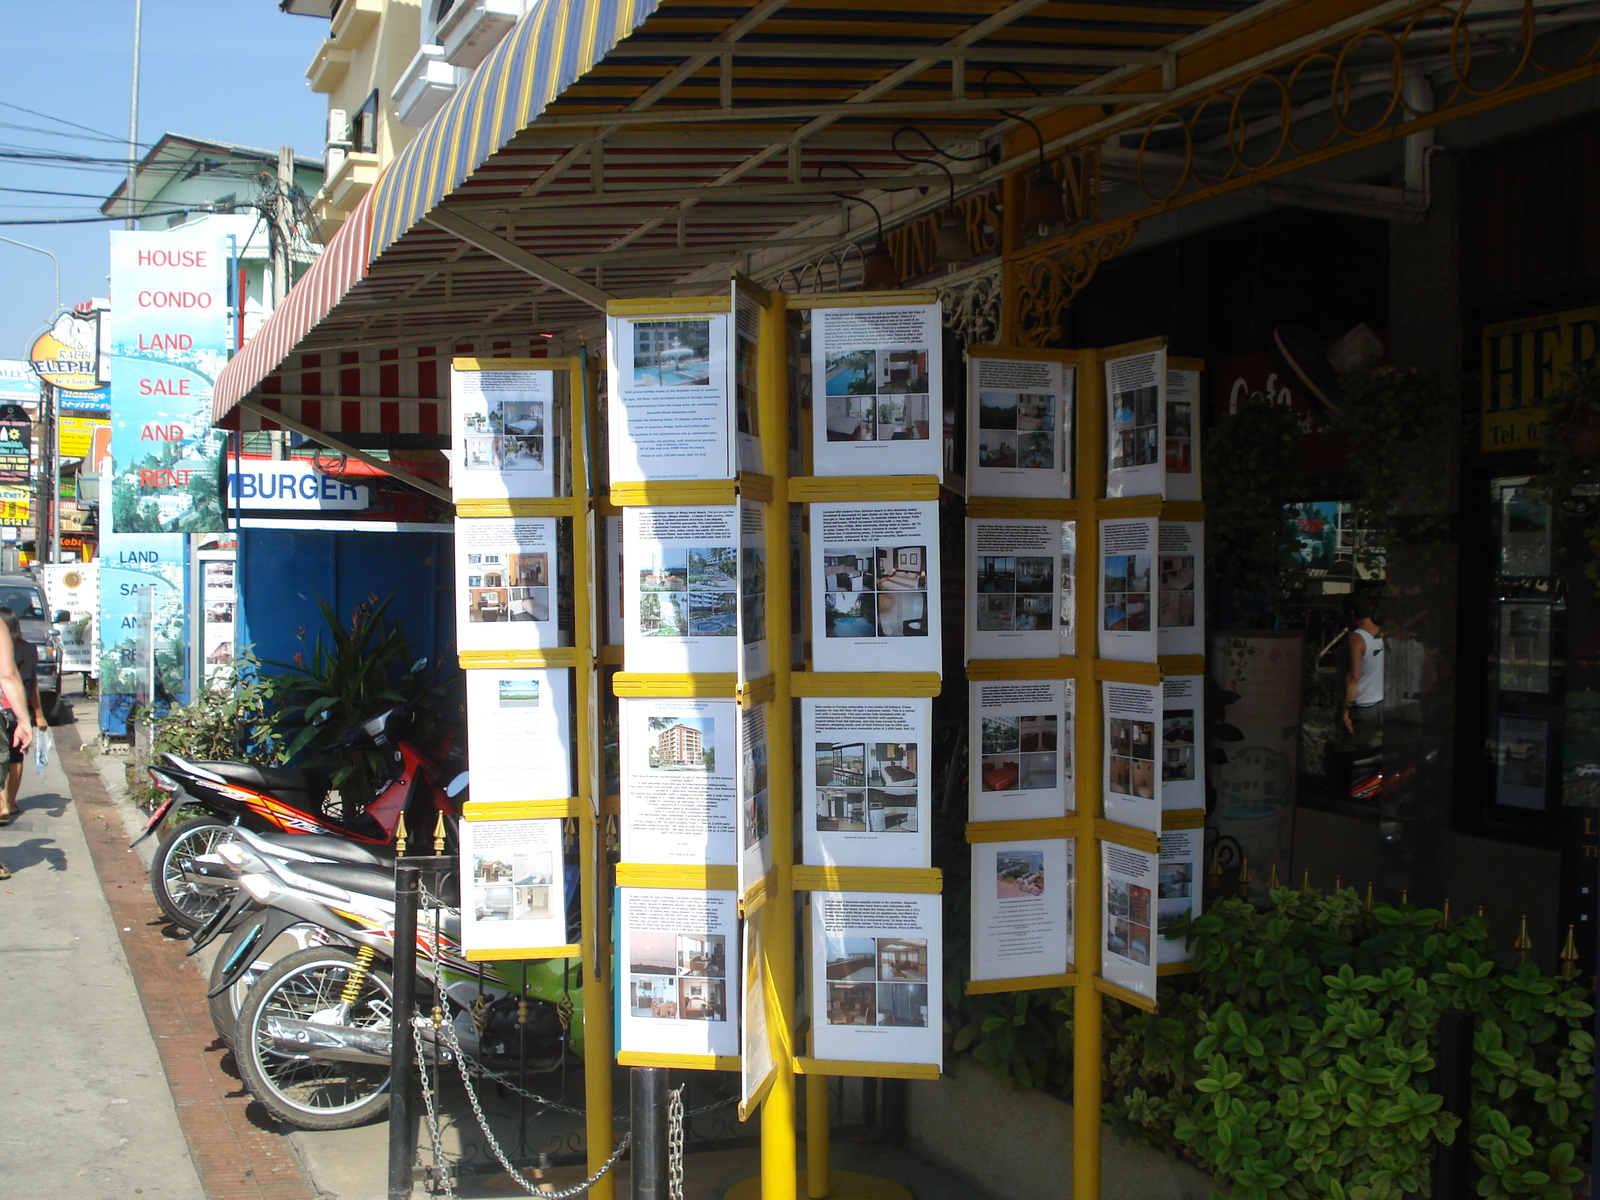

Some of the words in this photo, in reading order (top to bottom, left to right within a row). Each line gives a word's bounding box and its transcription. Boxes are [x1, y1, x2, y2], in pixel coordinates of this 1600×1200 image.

[138, 250, 207, 268] HOUSE
[138, 290, 212, 309] CONDO
[138, 333, 193, 351] LAND
[139, 378, 191, 396] SALE
[140, 425, 184, 442] AND
[1489, 425, 1521, 445] Tel.
[140, 469, 191, 488] RENT
[120, 551, 159, 563] LAND
